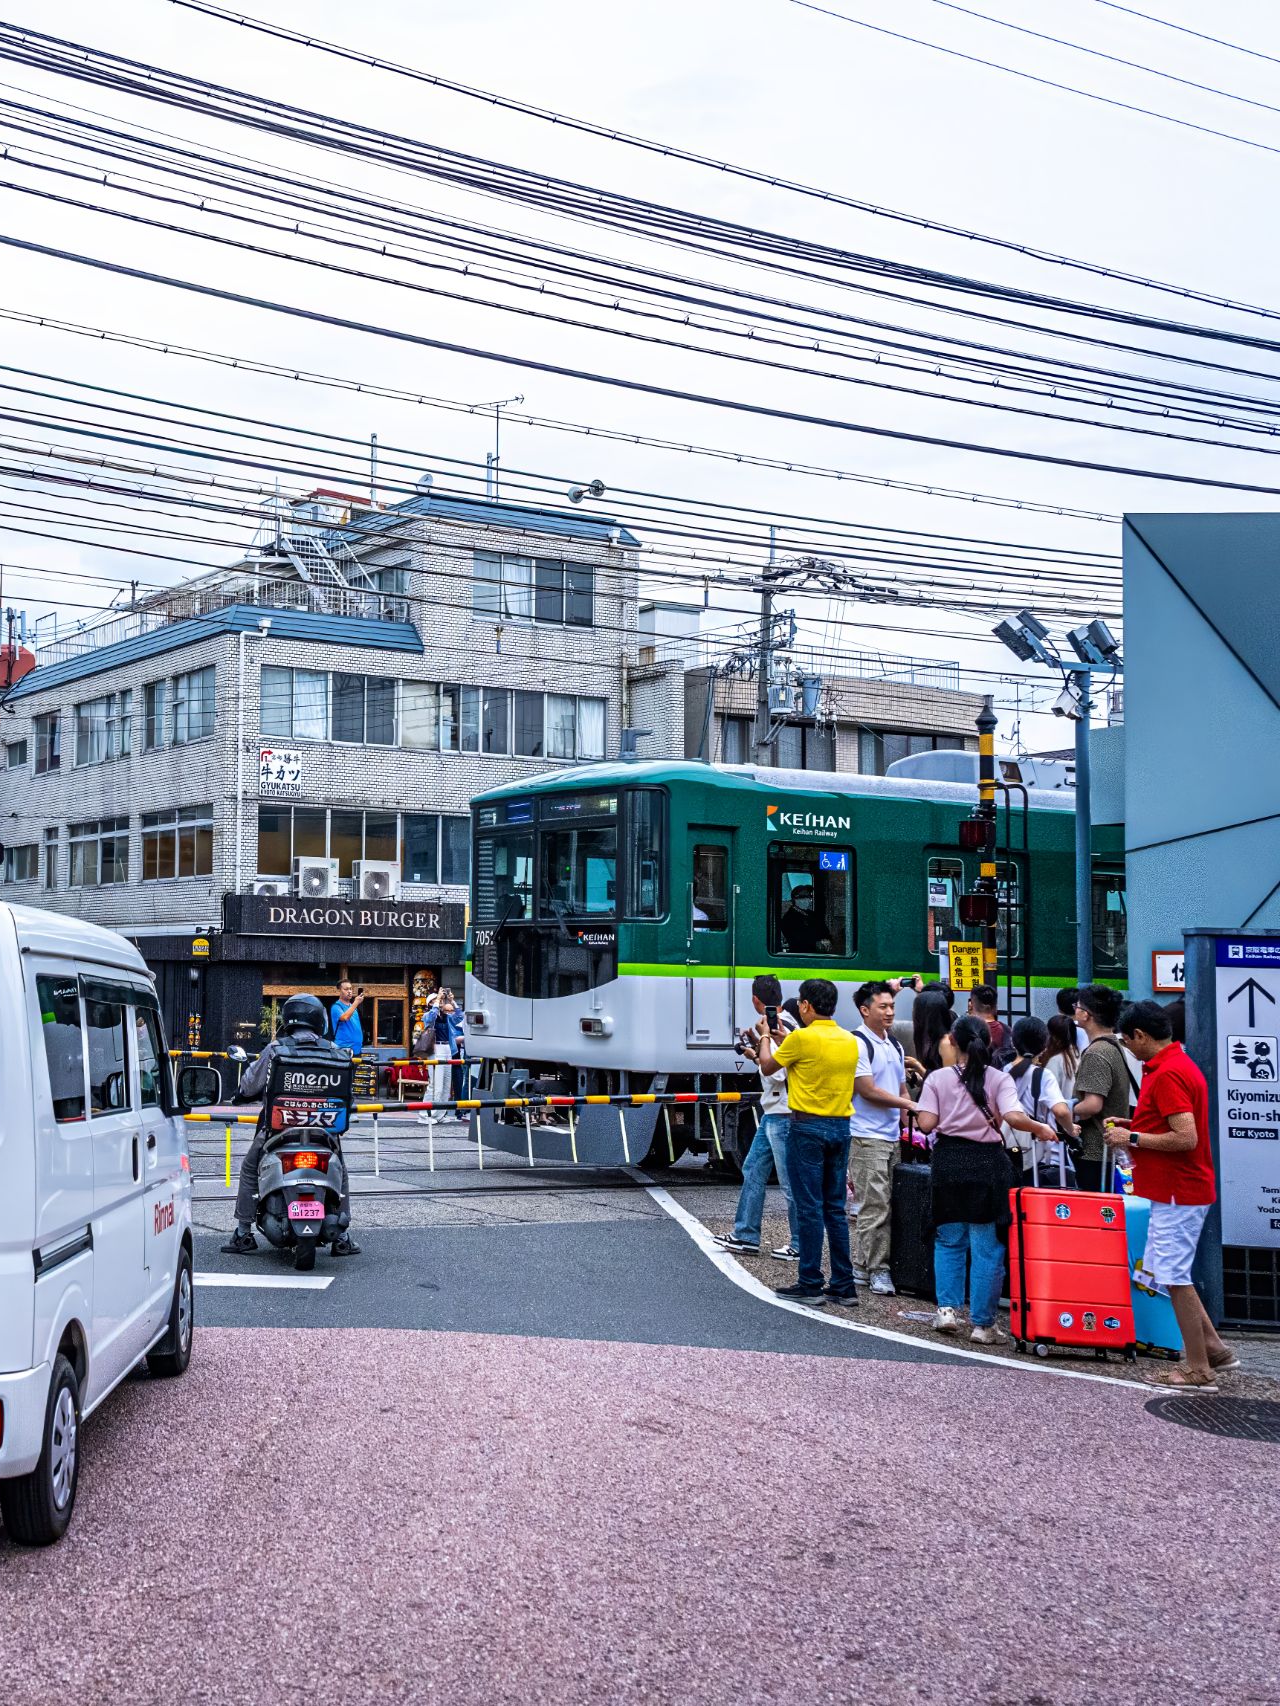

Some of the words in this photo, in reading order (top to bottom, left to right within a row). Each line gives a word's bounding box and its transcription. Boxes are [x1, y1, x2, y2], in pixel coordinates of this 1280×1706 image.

[261, 763, 300, 781] 牛カツ
[261, 782, 300, 791] GYUKATSU
[780, 812, 851, 829] KEIHAN
[792, 828, 813, 836] Keihan
[814, 829, 838, 838] Railway
[269, 907, 354, 926] DRAGON
[360, 910, 441, 929] BURGER
[583, 933, 615, 941] KEIHAN
[952, 945, 980, 954] Danger
[292, 1072, 341, 1086] menu
[281, 1110, 339, 1126] ドラスマ
[1232, 1128, 1245, 1137] for
[1247, 1130, 1275, 1139] Kyoto
[154, 1193, 175, 1237] Rinnai
[300, 1209, 320, 1217] 1237
